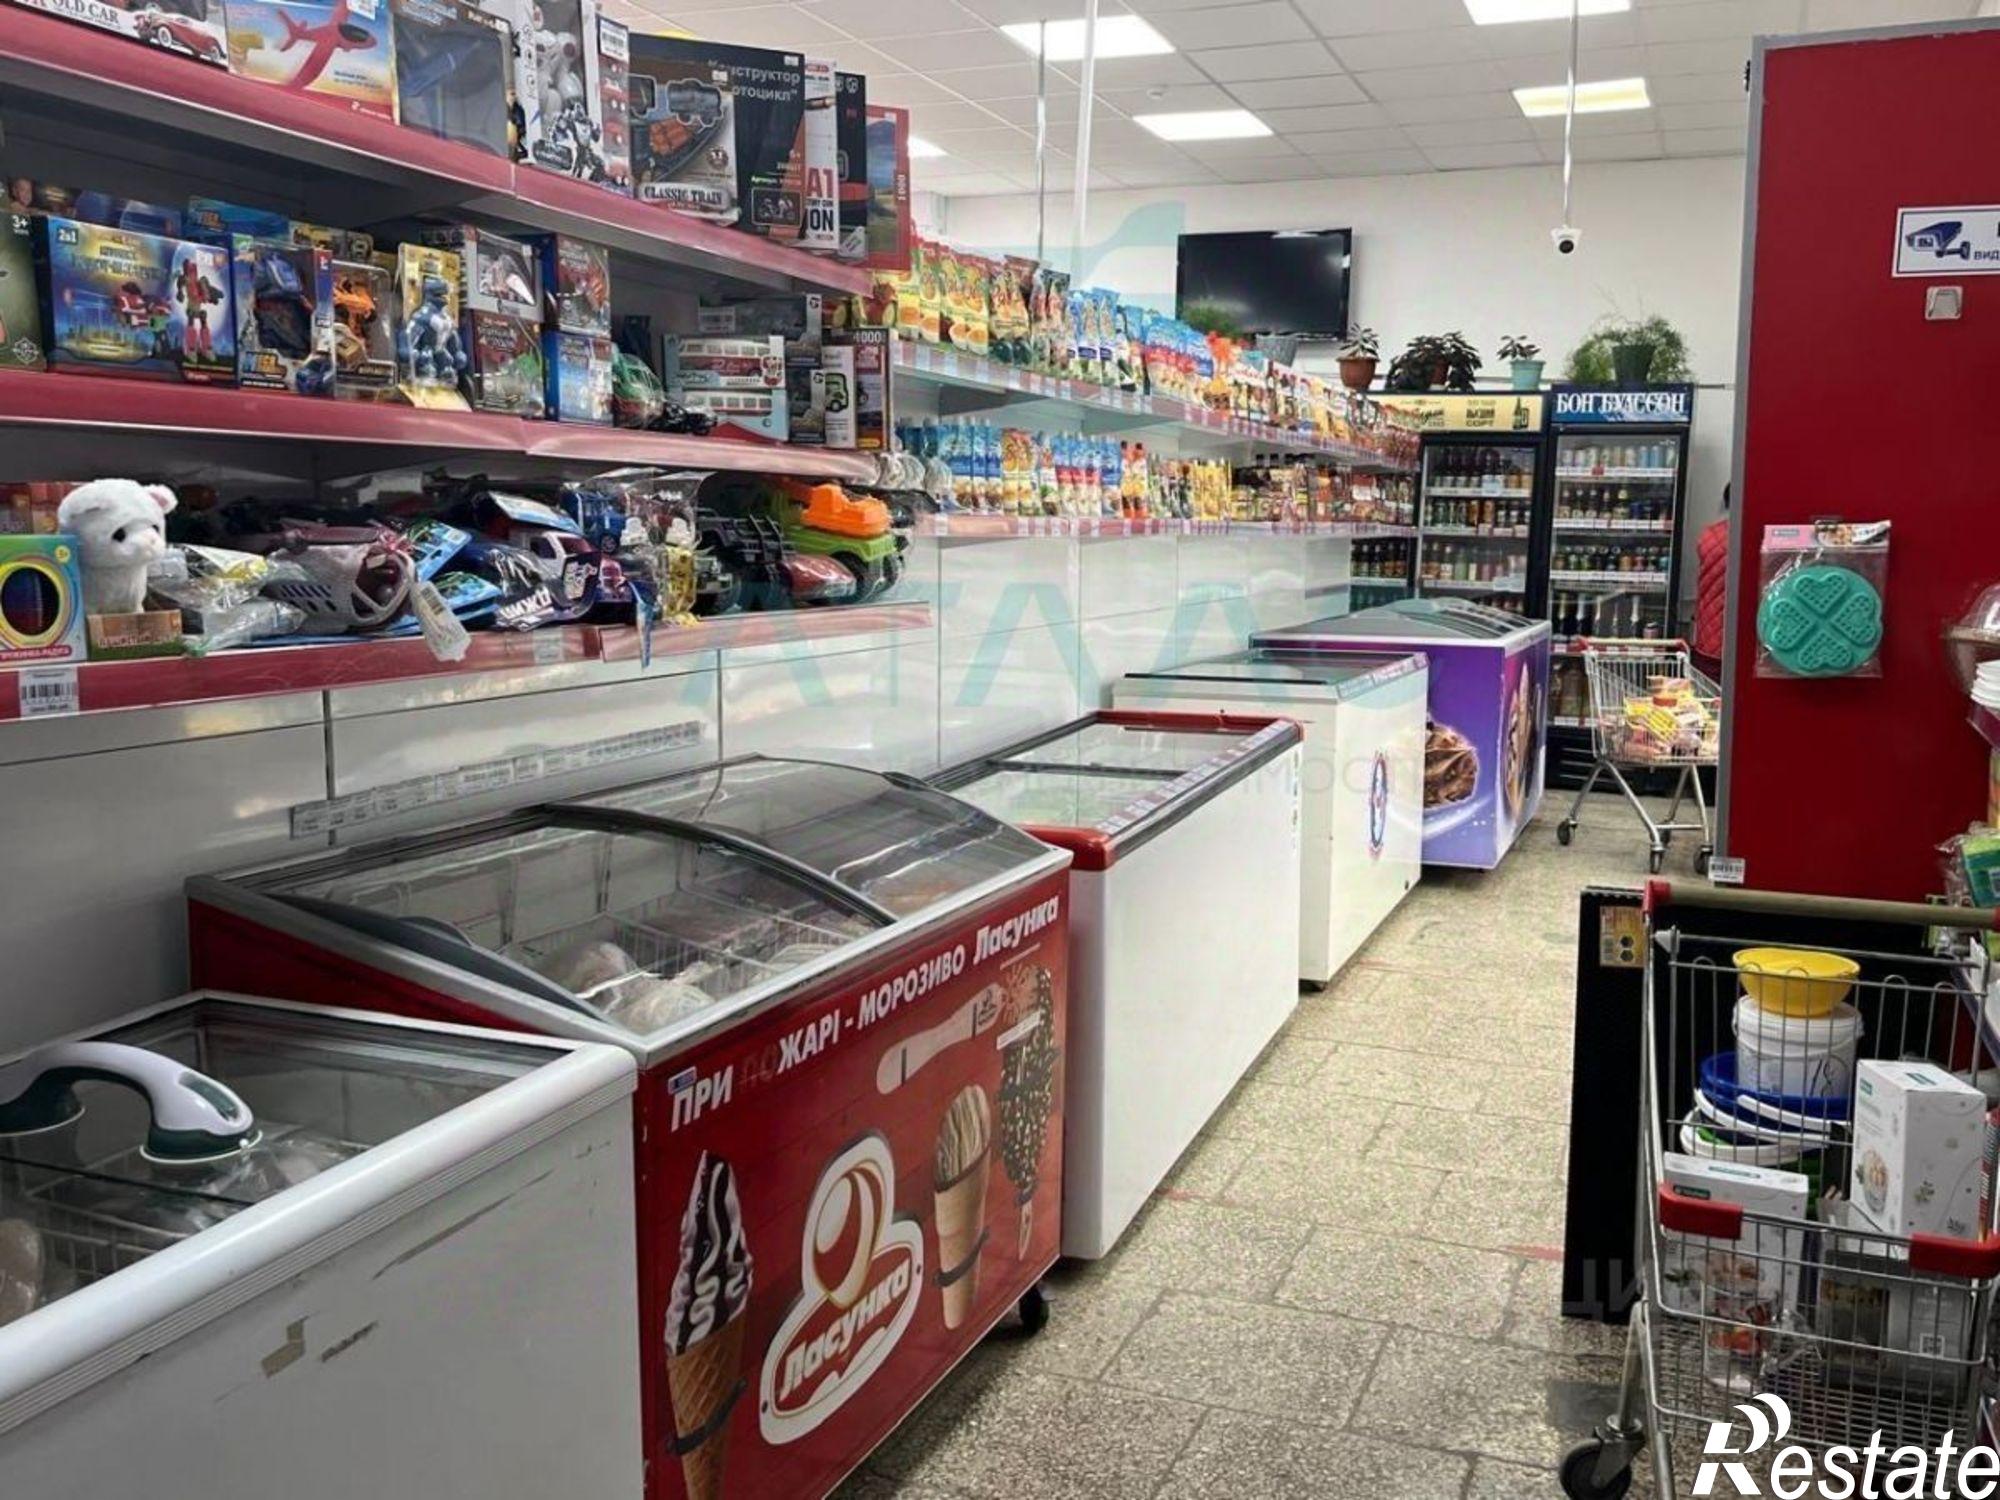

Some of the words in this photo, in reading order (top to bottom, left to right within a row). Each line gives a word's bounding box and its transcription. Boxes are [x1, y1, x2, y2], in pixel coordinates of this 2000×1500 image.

[88, 3, 119, 24] CAR
[731, 87, 798, 101] отоцикл"
[644, 186, 689, 200] CLASSIC
[690, 189, 722, 204] TRAIN
[897, 174, 906, 200] 1000
[12, 215, 28, 228] 3+
[1556, 393, 1594, 415] БОН
[671, 1065, 734, 1133] ПРИ
[856, 944, 966, 1031] МОРОЗИВО
[972, 895, 1060, 965] Ласунка
[778, 1258, 911, 1401] Ласунка
